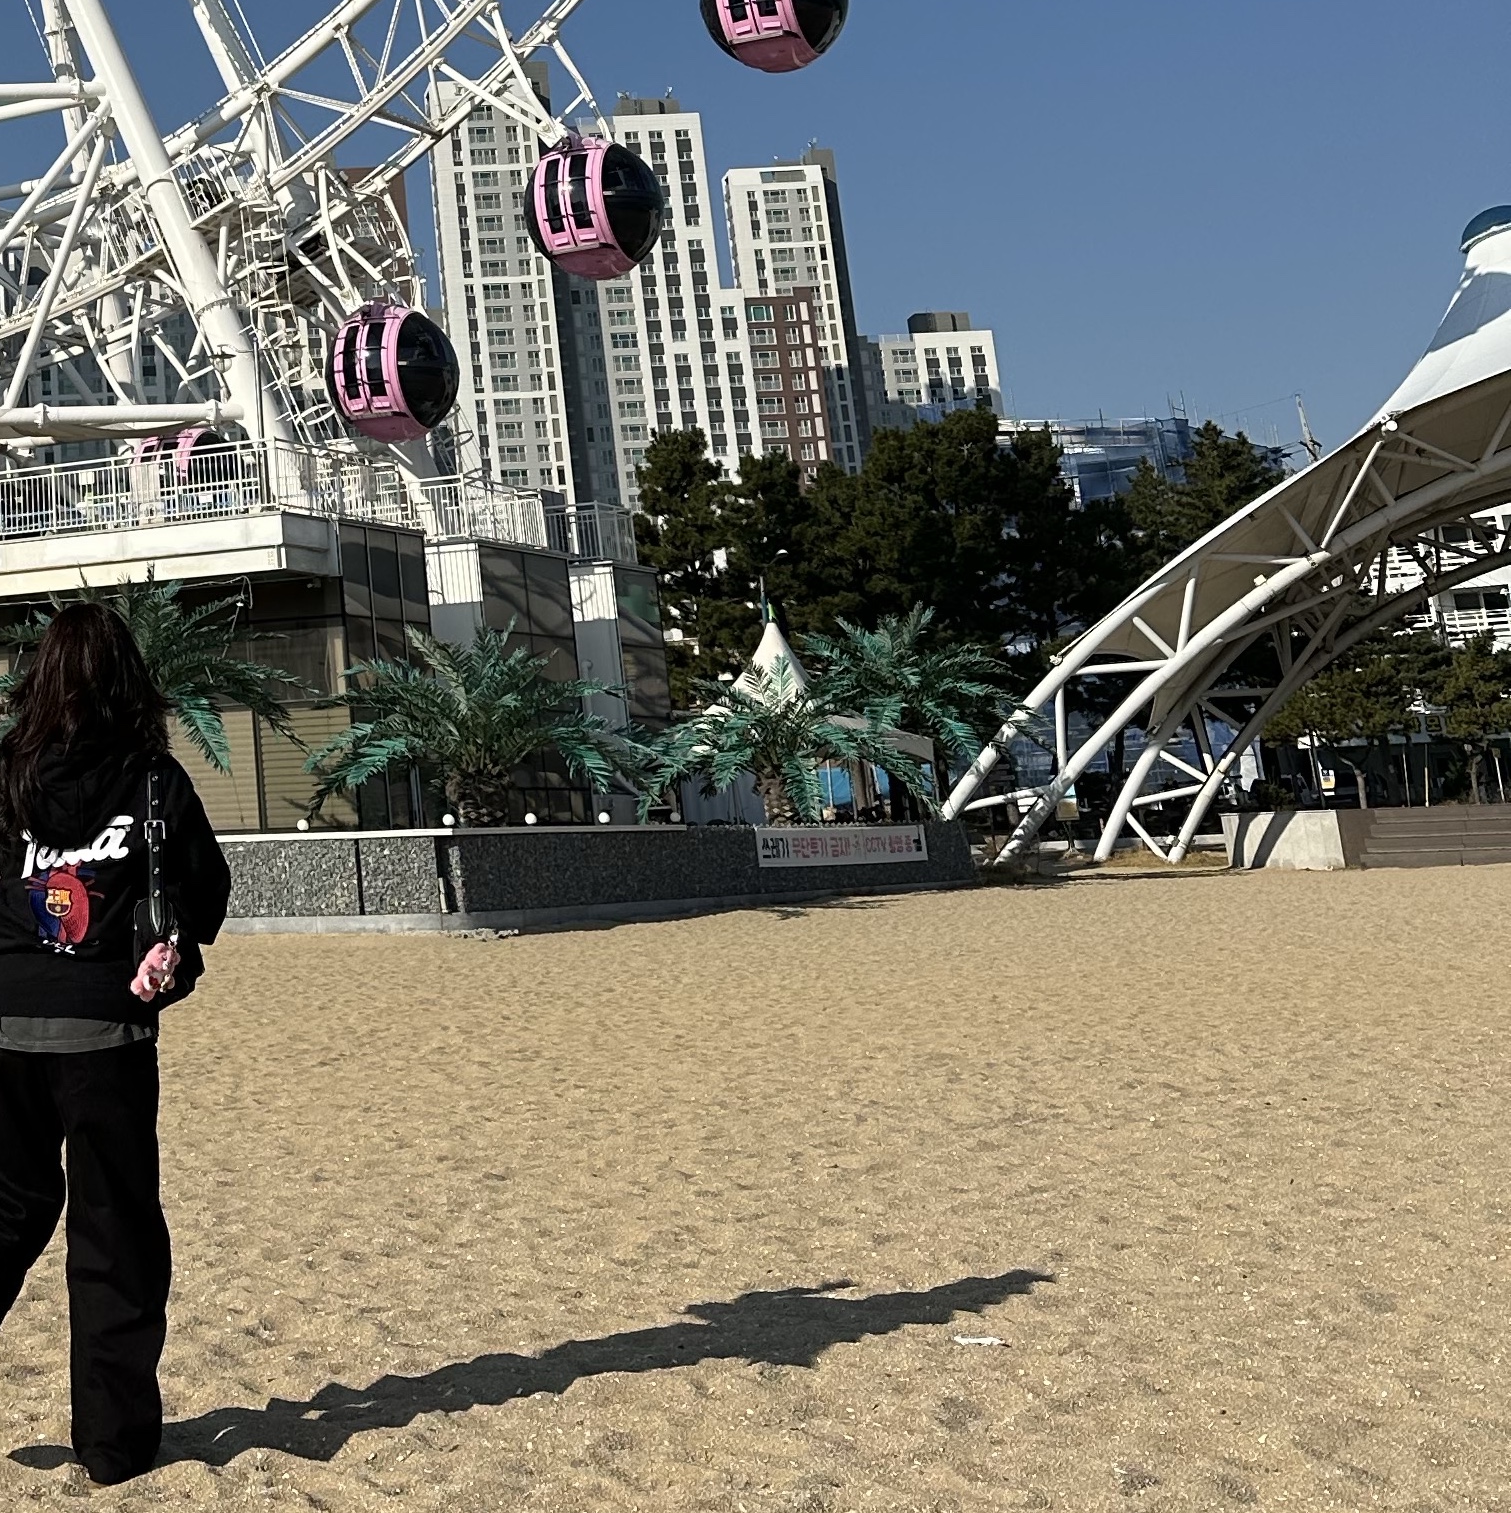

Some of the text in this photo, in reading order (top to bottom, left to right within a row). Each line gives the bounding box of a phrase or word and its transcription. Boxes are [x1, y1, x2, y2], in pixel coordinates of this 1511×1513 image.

[761, 837, 790, 859] 쓰레기
[792, 837, 828, 859] 무단투기
[865, 836, 887, 853] CCTV
